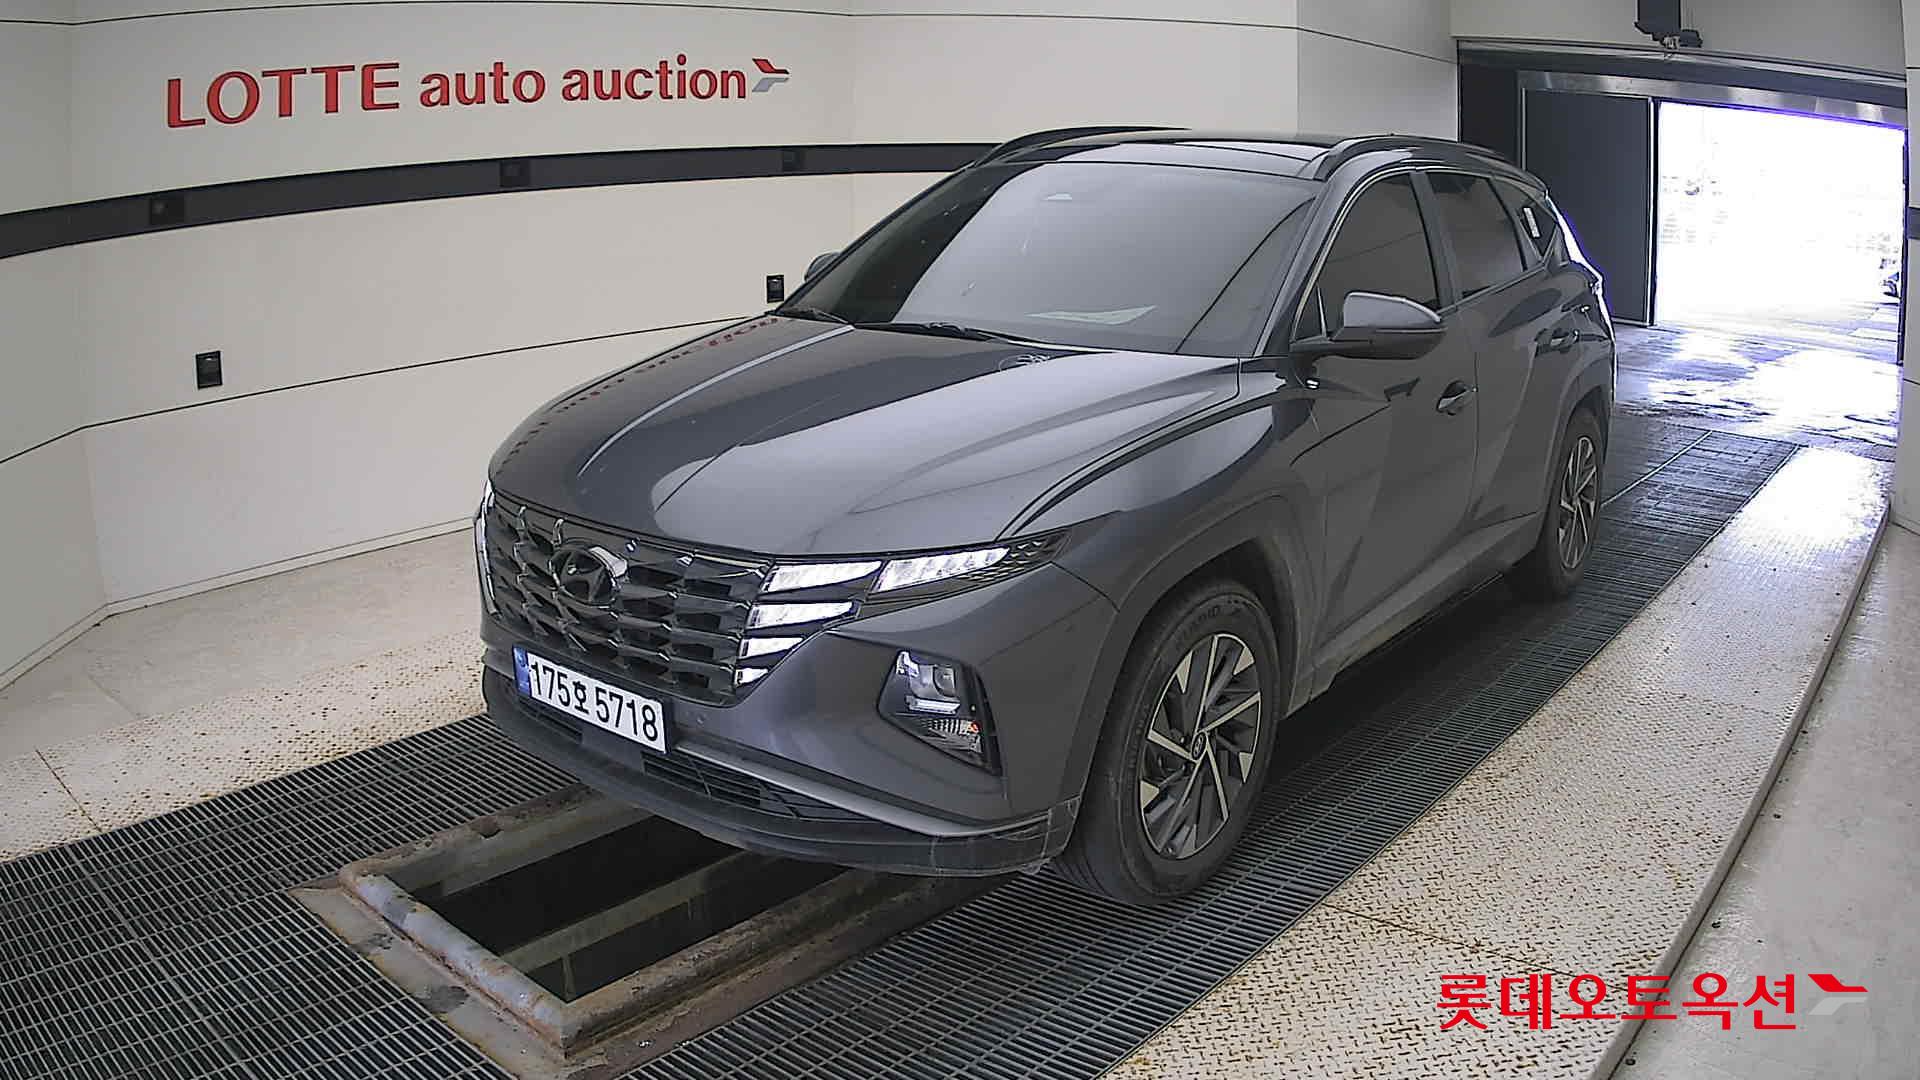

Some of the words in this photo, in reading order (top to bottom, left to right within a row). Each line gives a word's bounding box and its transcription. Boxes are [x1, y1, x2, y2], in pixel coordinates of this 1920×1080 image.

[167, 62, 400, 128] LOTTE
[419, 62, 546, 108] auto
[561, 54, 746, 102] auction
[531, 662, 589, 715] 175호
[595, 687, 658, 741] 5718
